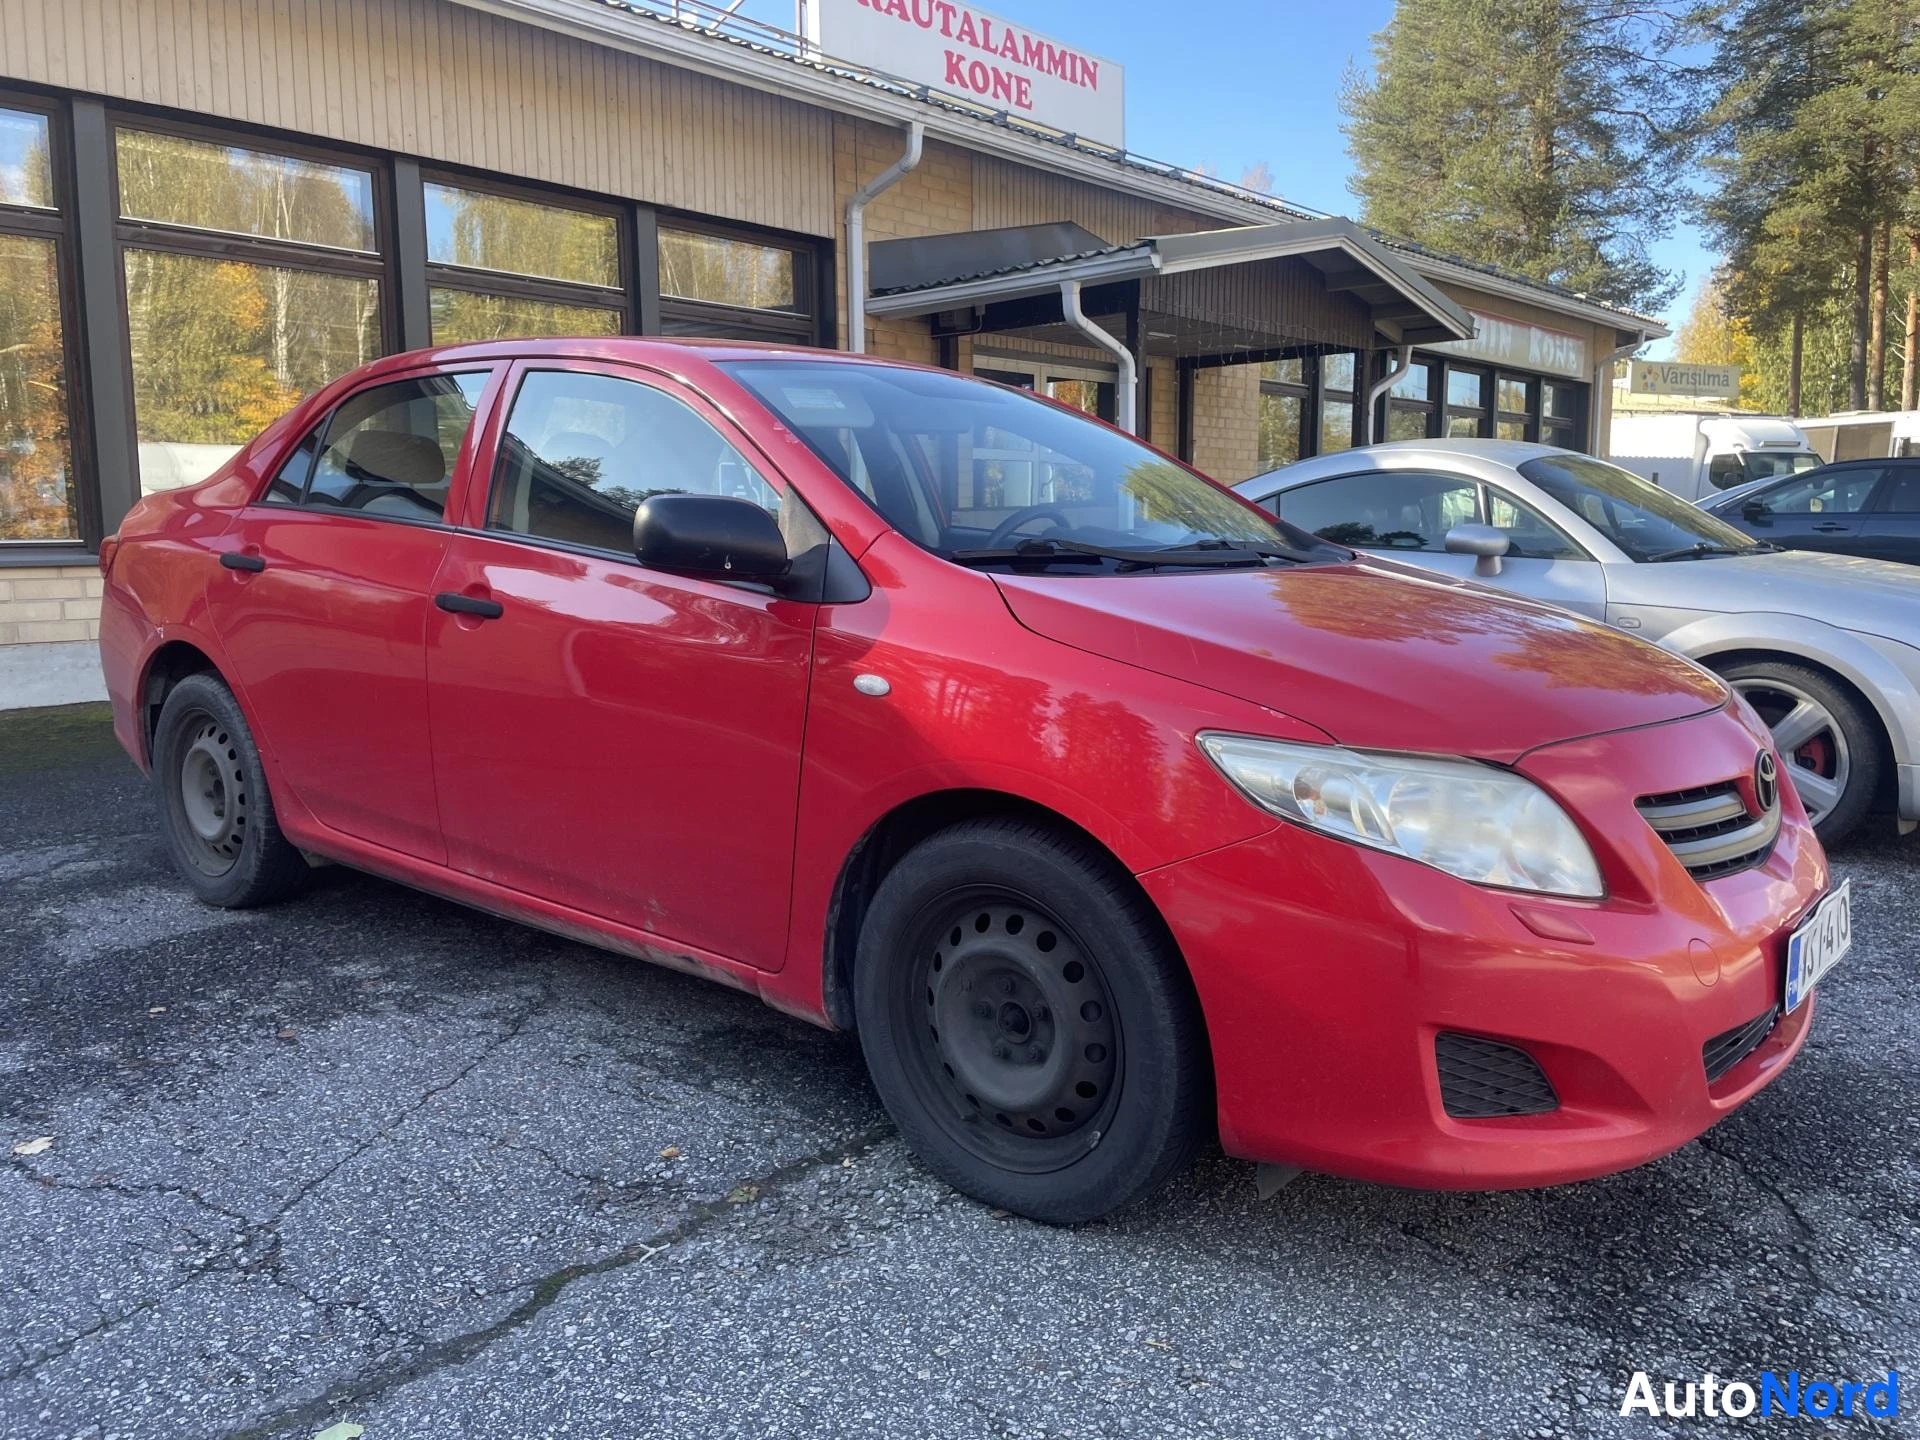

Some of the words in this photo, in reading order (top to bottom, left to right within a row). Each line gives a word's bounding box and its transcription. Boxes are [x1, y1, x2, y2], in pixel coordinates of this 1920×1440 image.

[857, 0, 1098, 91] AUTALAMMIN
[944, 50, 1033, 110] KONE
[1529, 326, 1577, 369] KONE
[1661, 366, 1730, 388] Värisilmä
